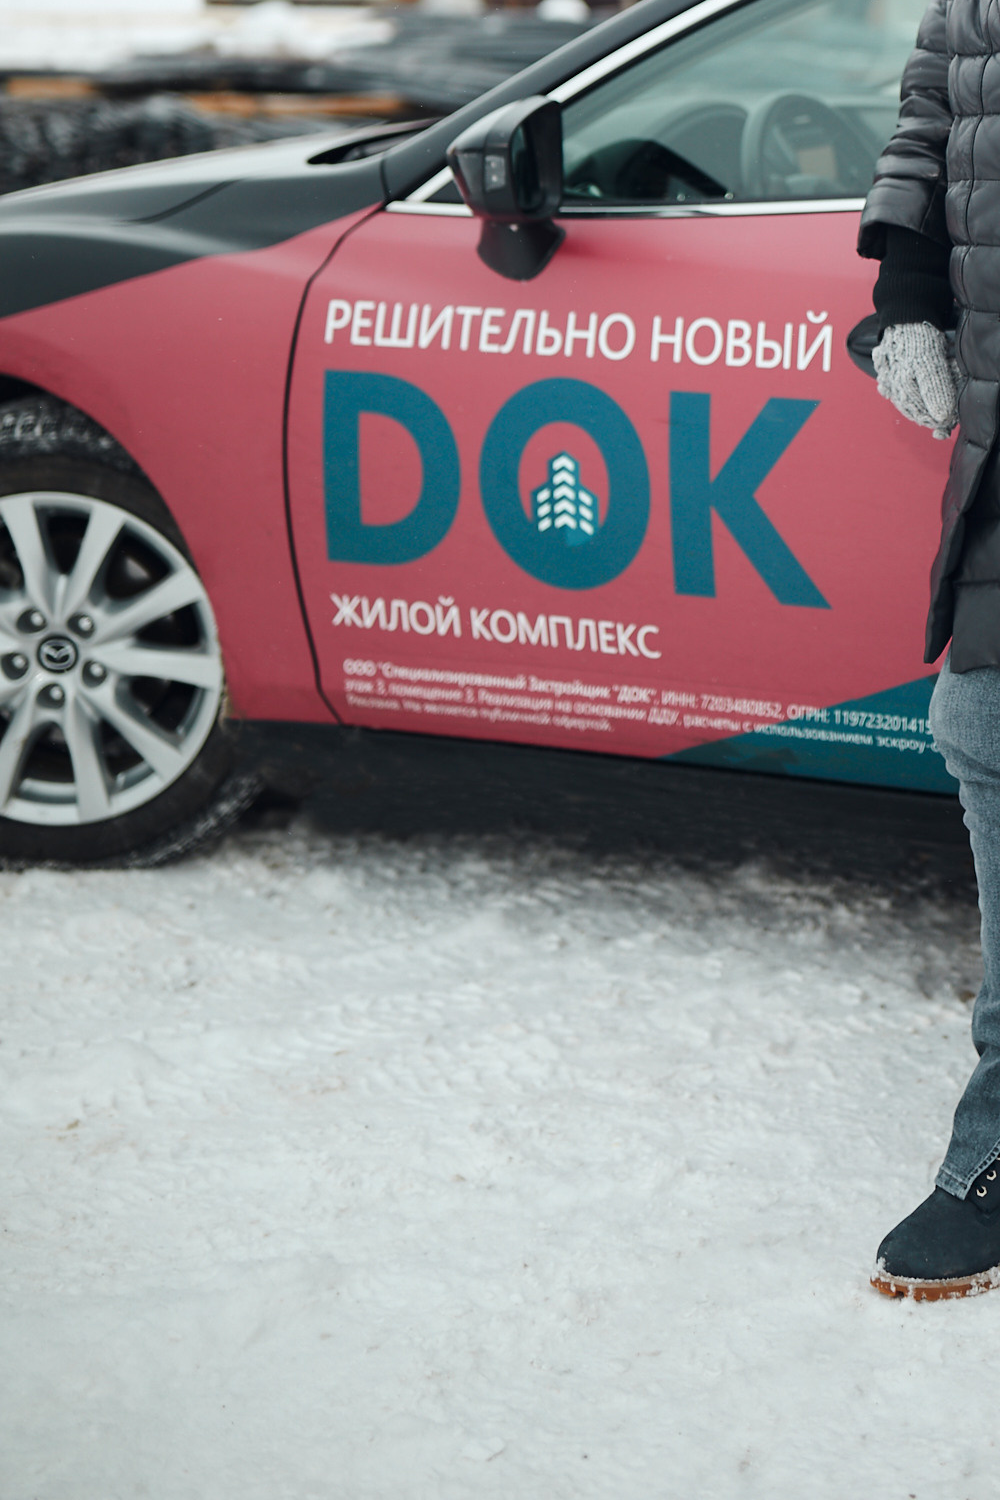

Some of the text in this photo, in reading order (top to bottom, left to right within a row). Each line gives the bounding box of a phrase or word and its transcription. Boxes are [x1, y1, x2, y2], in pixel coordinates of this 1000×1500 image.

[324, 299, 834, 372] РЕШИТЕЛЬНО НОВЫЙ
[322, 368, 834, 610] DOK
[330, 592, 663, 660] ЖИЛОЙ КОМПЛЕКС
[343, 658, 377, 677] ООО
[528, 675, 611, 699] Застройщик
[787, 703, 830, 724] ОГРН:
[754, 723, 874, 746] использованием
